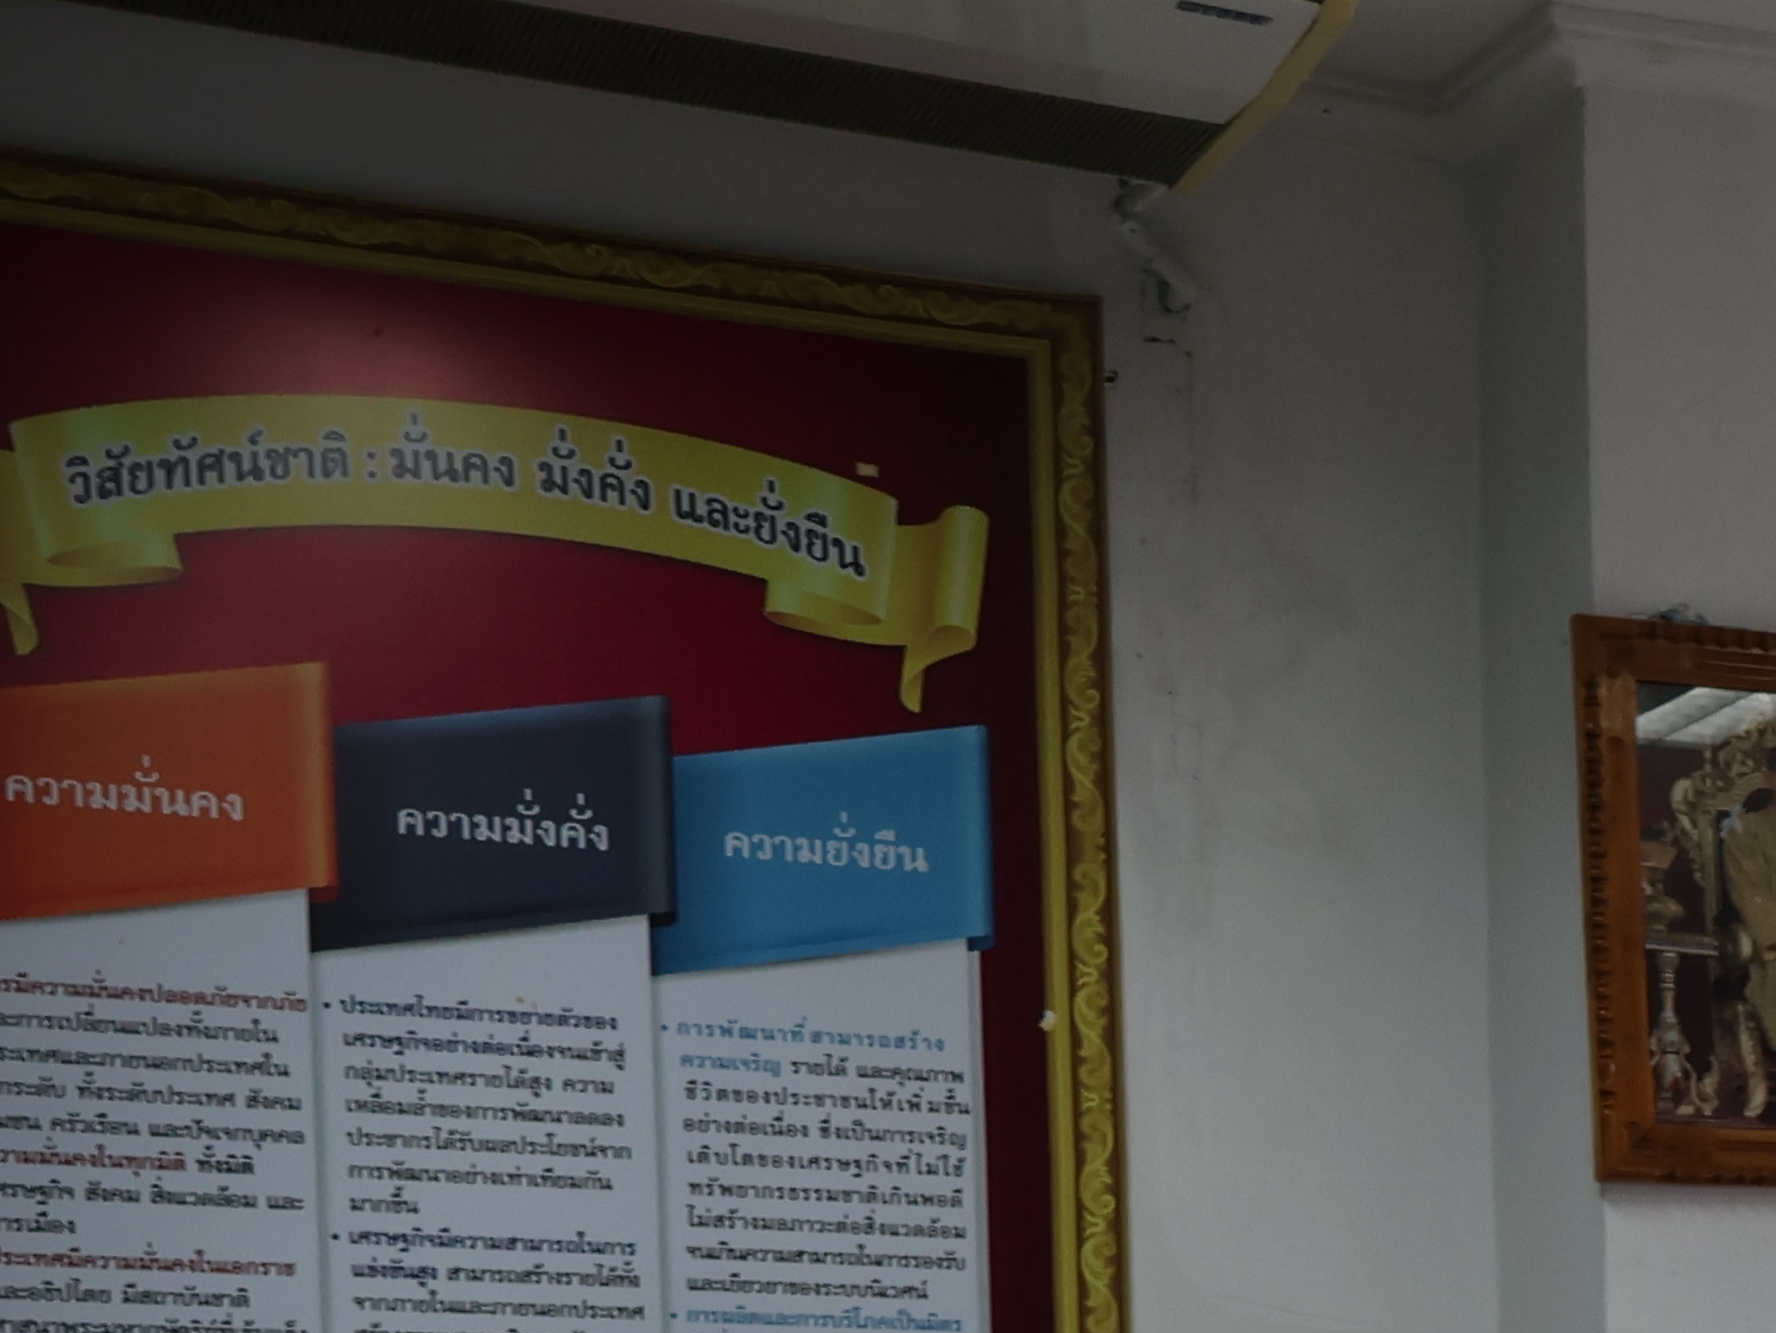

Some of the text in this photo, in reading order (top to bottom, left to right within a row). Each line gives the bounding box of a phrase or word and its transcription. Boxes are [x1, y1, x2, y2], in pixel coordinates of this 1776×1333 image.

[66, 430, 350, 507] วิสัยทัศน์ชาติ
[391, 412, 517, 489] มั่นคง
[538, 427, 652, 515] มั่งคั่ง
[672, 479, 866, 579] และยั่งยืน
[4, 755, 245, 823] ความมั่นคง
[397, 789, 612, 853] ความมั่งคั่ง
[723, 811, 930, 875] ความยั่งยืน
